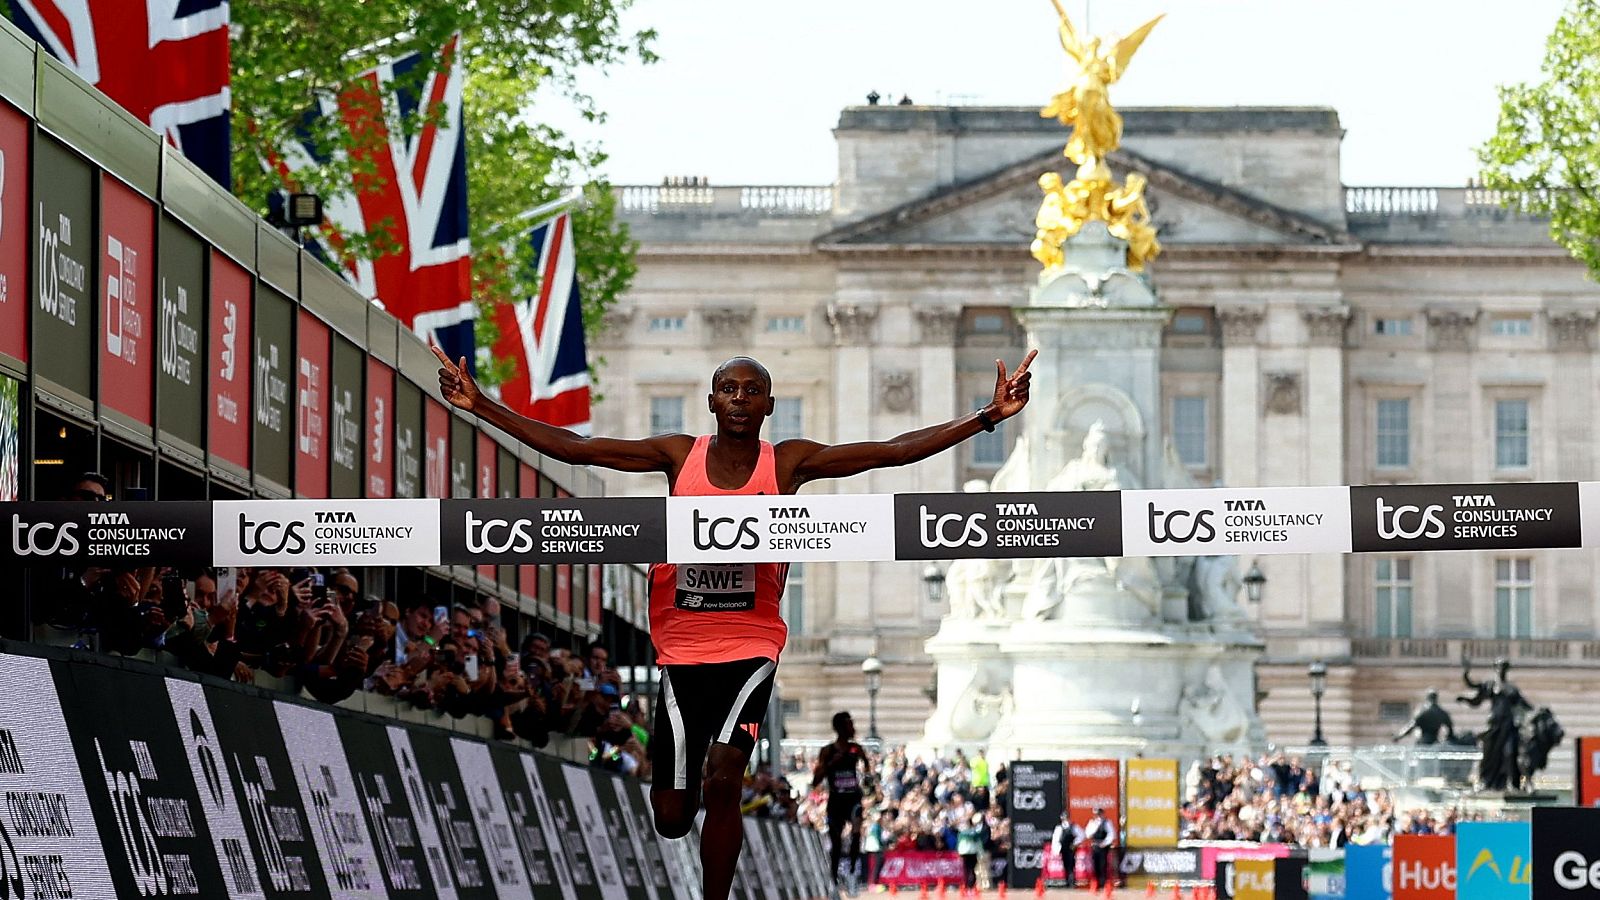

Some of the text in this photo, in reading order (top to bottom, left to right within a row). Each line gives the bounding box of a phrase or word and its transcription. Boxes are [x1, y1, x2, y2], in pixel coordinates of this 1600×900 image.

[39, 201, 58, 316] tcs
[1224, 500, 1265, 511] TATA
[1453, 495, 1495, 507] TATA
[541, 510, 583, 521] TATA
[769, 508, 810, 518] TATA
[996, 504, 1038, 515] TATA
[1453, 509, 1552, 522] CONSULTANCY
[88, 513, 129, 524] TATA
[315, 512, 356, 523] TATA
[1149, 502, 1215, 543] tcs
[1224, 514, 1323, 526] CONSULTANCY
[1377, 498, 1445, 539] tcs
[693, 509, 760, 550] tcs
[769, 522, 866, 534] CONSULTANCY
[920, 505, 987, 547] tcs
[996, 518, 1095, 531] CONSULTANCY
[13, 514, 79, 555] tcs
[88, 528, 185, 540] CONSULTANCY
[239, 513, 305, 554] tcs
[315, 527, 412, 538] CONSULTANCY
[466, 511, 532, 553] tcs
[541, 525, 640, 537] CONSULTANCY
[1225, 530, 1287, 542] SERVICES
[1453, 525, 1517, 538] SERVICES
[769, 538, 831, 549] SERVICES
[996, 534, 1059, 546] SERVICES
[88, 544, 150, 555] SERVICES
[315, 543, 376, 554] SERVICES
[541, 541, 604, 552] SERVICES
[686, 568, 743, 589] SAWE
[1013, 788, 1046, 810] tcs
[6, 791, 75, 838] CONSULTANCY
[94, 736, 168, 897] tcs
[23, 855, 73, 900] SERVICES
